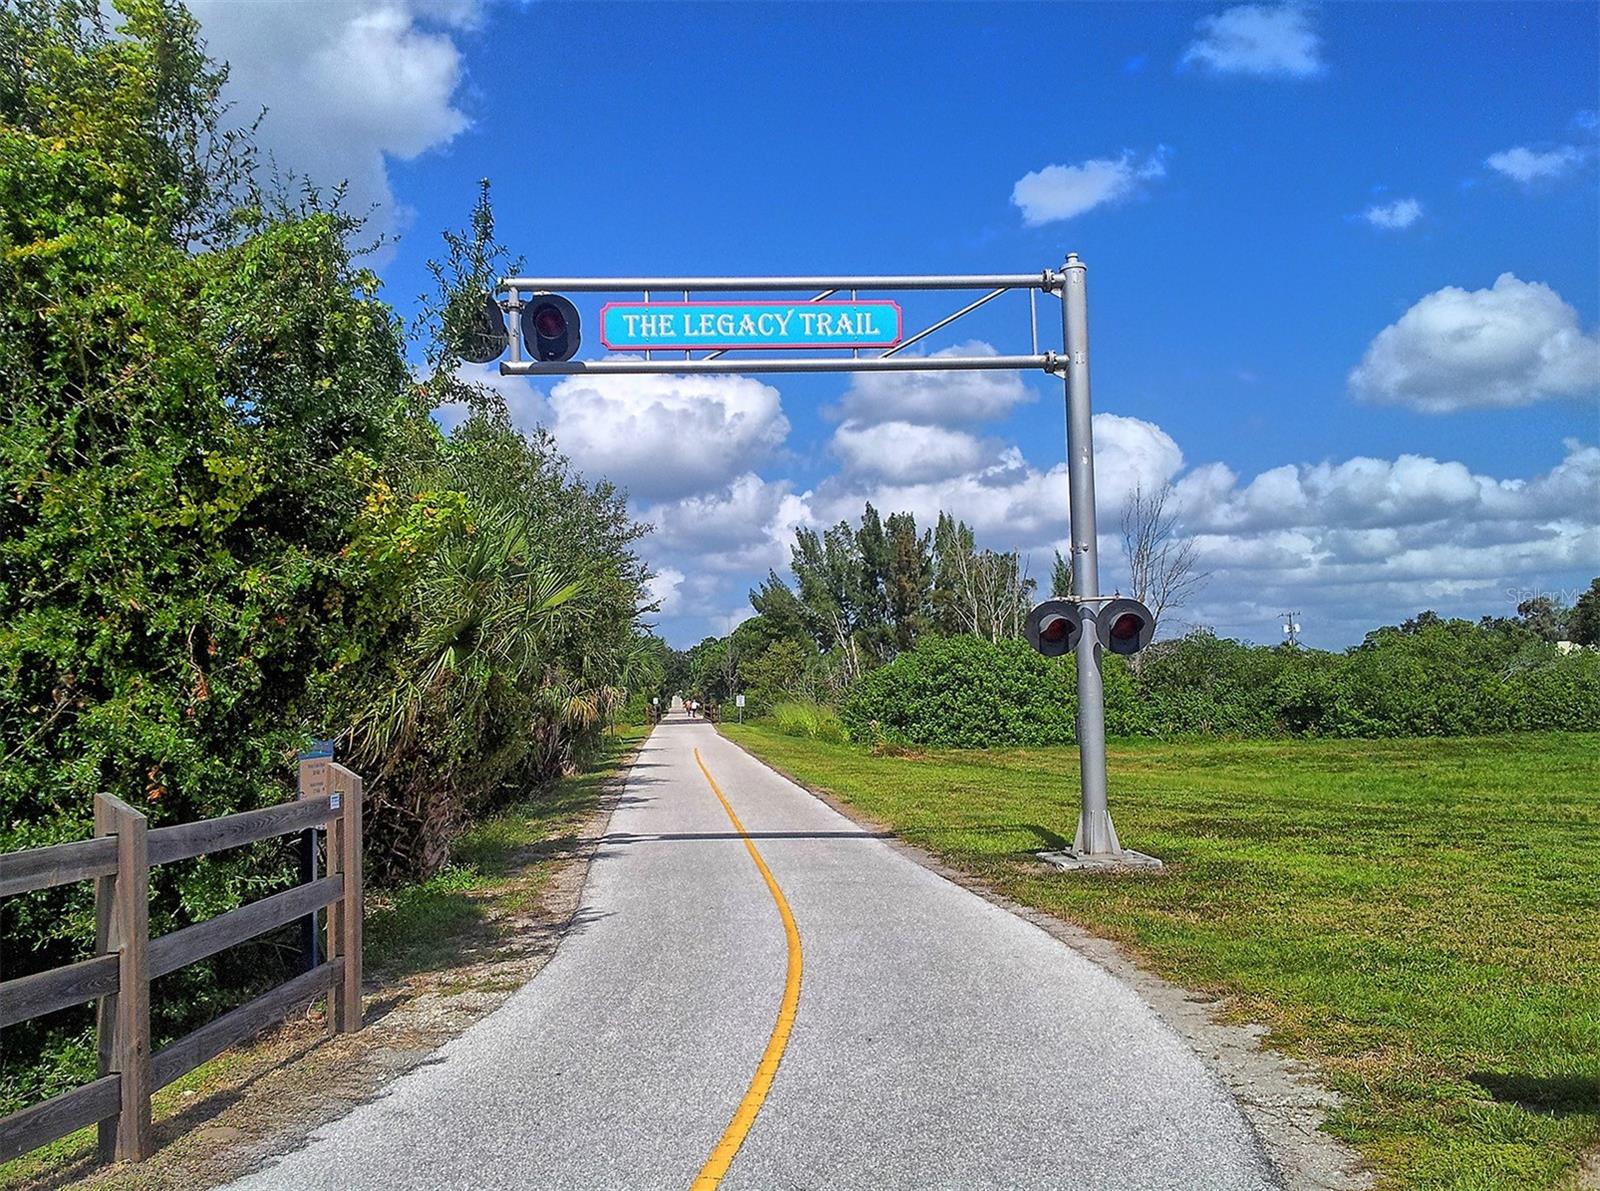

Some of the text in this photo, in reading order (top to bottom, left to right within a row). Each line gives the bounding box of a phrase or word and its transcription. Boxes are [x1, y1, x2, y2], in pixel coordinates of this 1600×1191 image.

[622, 310, 881, 338] THE LEGACY TRAIL
